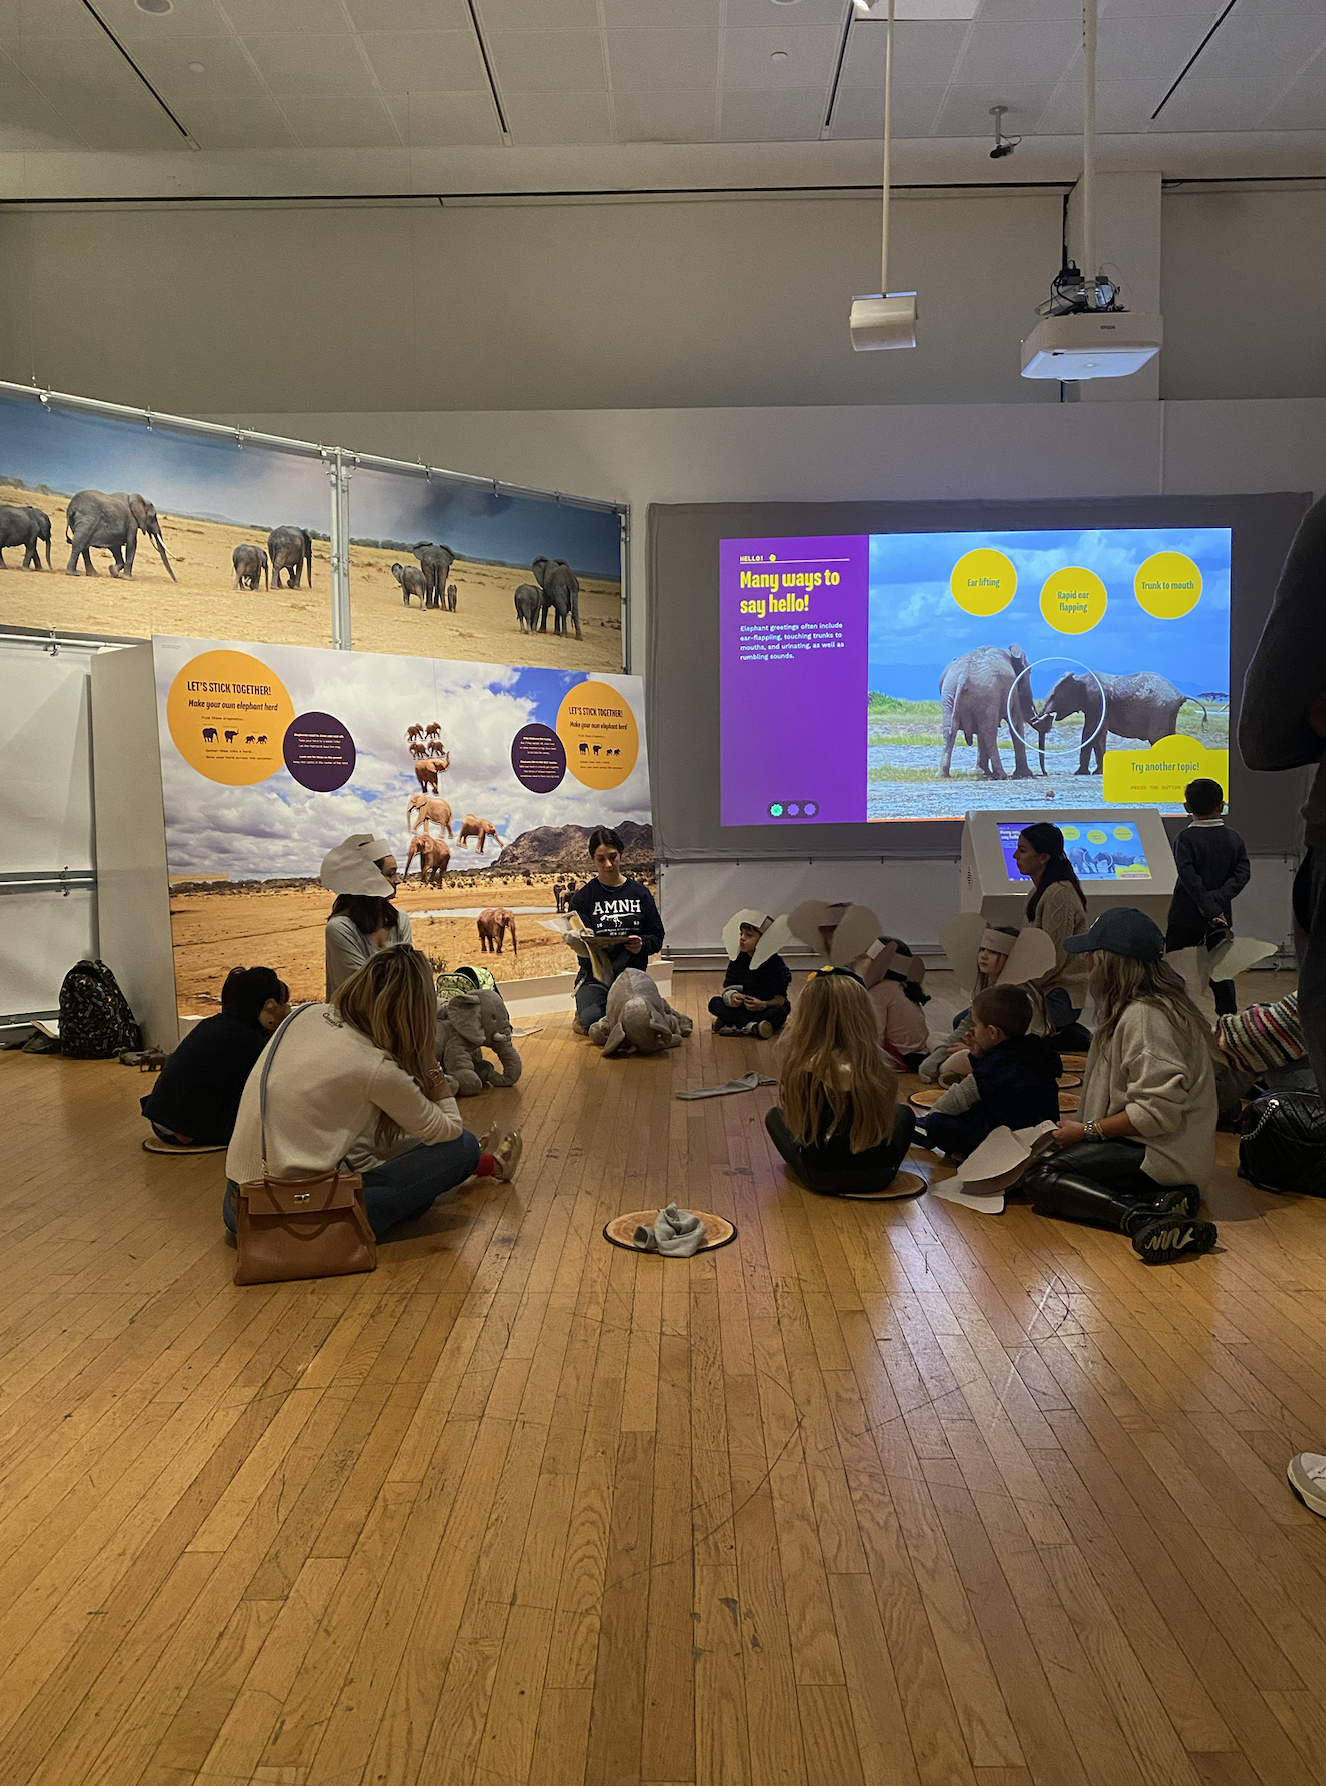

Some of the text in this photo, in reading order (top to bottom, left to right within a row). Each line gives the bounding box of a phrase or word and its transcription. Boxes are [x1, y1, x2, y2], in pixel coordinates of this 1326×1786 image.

[740, 569, 840, 592] Many ways to
[967, 578, 1000, 588] Ear lifting
[1142, 580, 1194, 590] Trunk to mouth
[1057, 590, 1077, 601] Rapid
[740, 592, 809, 618] say hello!
[1059, 602, 1088, 614] flapping
[740, 624, 768, 632] Elephant
[770, 624, 799, 632] greetings
[784, 632, 812, 640] touching
[188, 681, 272, 696] LET'S STICK TOGETHER!
[188, 699, 205, 708] Make
[206, 702, 221, 710] your
[236, 701, 264, 712] elephant
[264, 702, 278, 711] herd
[568, 706, 623, 718] LET'S STICK TOGETHER!
[600, 722, 618, 730] elephant
[1131, 761, 1200, 774] Try another topic!
[592, 898, 642, 916] AMNH
